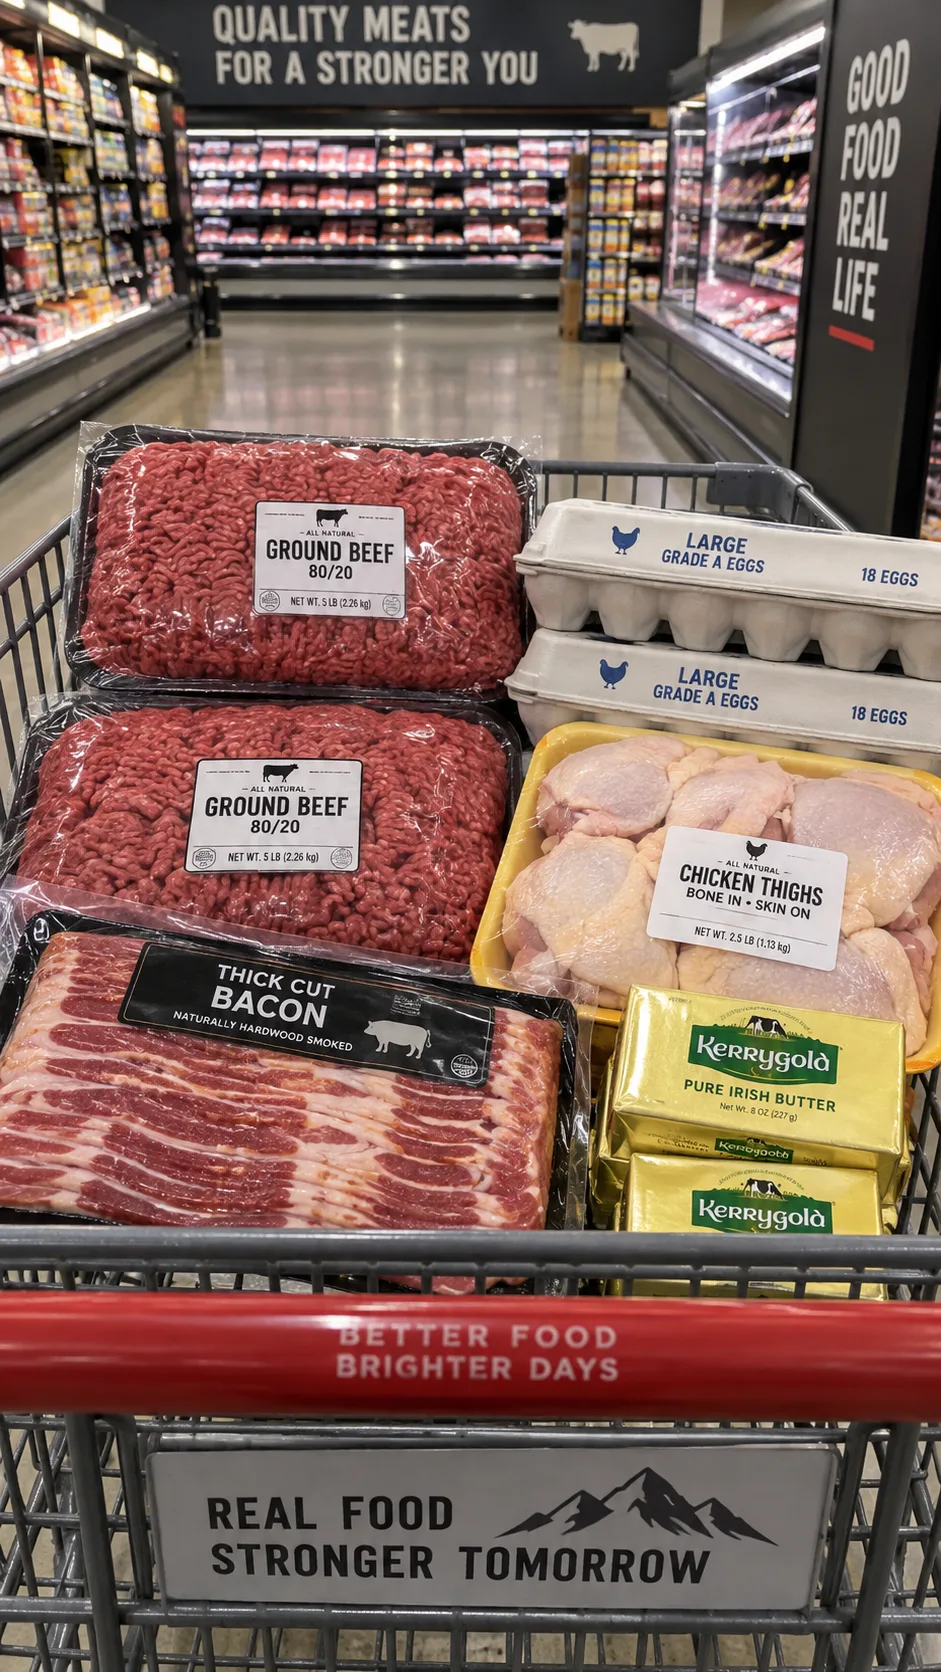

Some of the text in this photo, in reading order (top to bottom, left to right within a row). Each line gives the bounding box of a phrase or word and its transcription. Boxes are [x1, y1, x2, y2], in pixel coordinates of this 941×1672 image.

[213, 5, 471, 45] QUALITY MEATS
[216, 51, 538, 85] FOR A STRONGER YOU
[847, 38, 911, 115] GOOD
[840, 116, 901, 181] FOOD
[836, 191, 889, 251] REAL
[832, 257, 879, 321] LIFE
[266, 539, 395, 564] GROUND BEEF
[686, 532, 748, 554] LARGE
[309, 564, 353, 580] 80/20
[661, 549, 765, 573] GRADE A EGGS
[861, 567, 919, 587] 18 EGGS
[291, 596, 305, 606] NET
[307, 597, 320, 607] WT.
[322, 597, 327, 607] 5
[329, 598, 338, 607] LB
[340, 598, 358, 609] (2.26
[360, 599, 372, 611] kg)
[678, 667, 740, 690] LARGE
[653, 684, 759, 711] GRADE A EGGS
[851, 705, 908, 726] 18 EGGS
[205, 796, 349, 817] GROUND BEEF
[251, 819, 300, 835] 80/20
[228, 852, 244, 862] NET
[246, 852, 261, 862] WT.
[263, 852, 269, 862] 5
[270, 852, 281, 862] LB
[283, 851, 304, 863] (2.26
[306, 852, 319, 864] kg)
[726, 860, 780, 876] ALL NATURAL
[679, 864, 823, 906] CHICKEN THIGHS
[686, 887, 811, 920] BONE IN SKIN ON
[694, 926, 791, 954] NET WT. 2.5 LB (1.13 kg)
[218, 964, 335, 999] THICK CUT
[211, 985, 327, 1028] BACON
[173, 1011, 353, 1051] NATURALLY HARDWOOD SMOKED
[697, 1034, 830, 1073] Kerrygold
[684, 1079, 836, 1112] PURE IRISH BUTTER
[719, 1102, 734, 1111] Net
[750, 1107, 756, 1115] 8
[771, 1109, 788, 1120] (227
[699, 1198, 825, 1231] Kerrygold
[339, 1322, 617, 1349] BETTER FOOD
[336, 1353, 619, 1382] BRIGHTER DAYS
[206, 1495, 453, 1531] REAL FOOD
[211, 1543, 711, 1584] STRONGER TOMORROW
